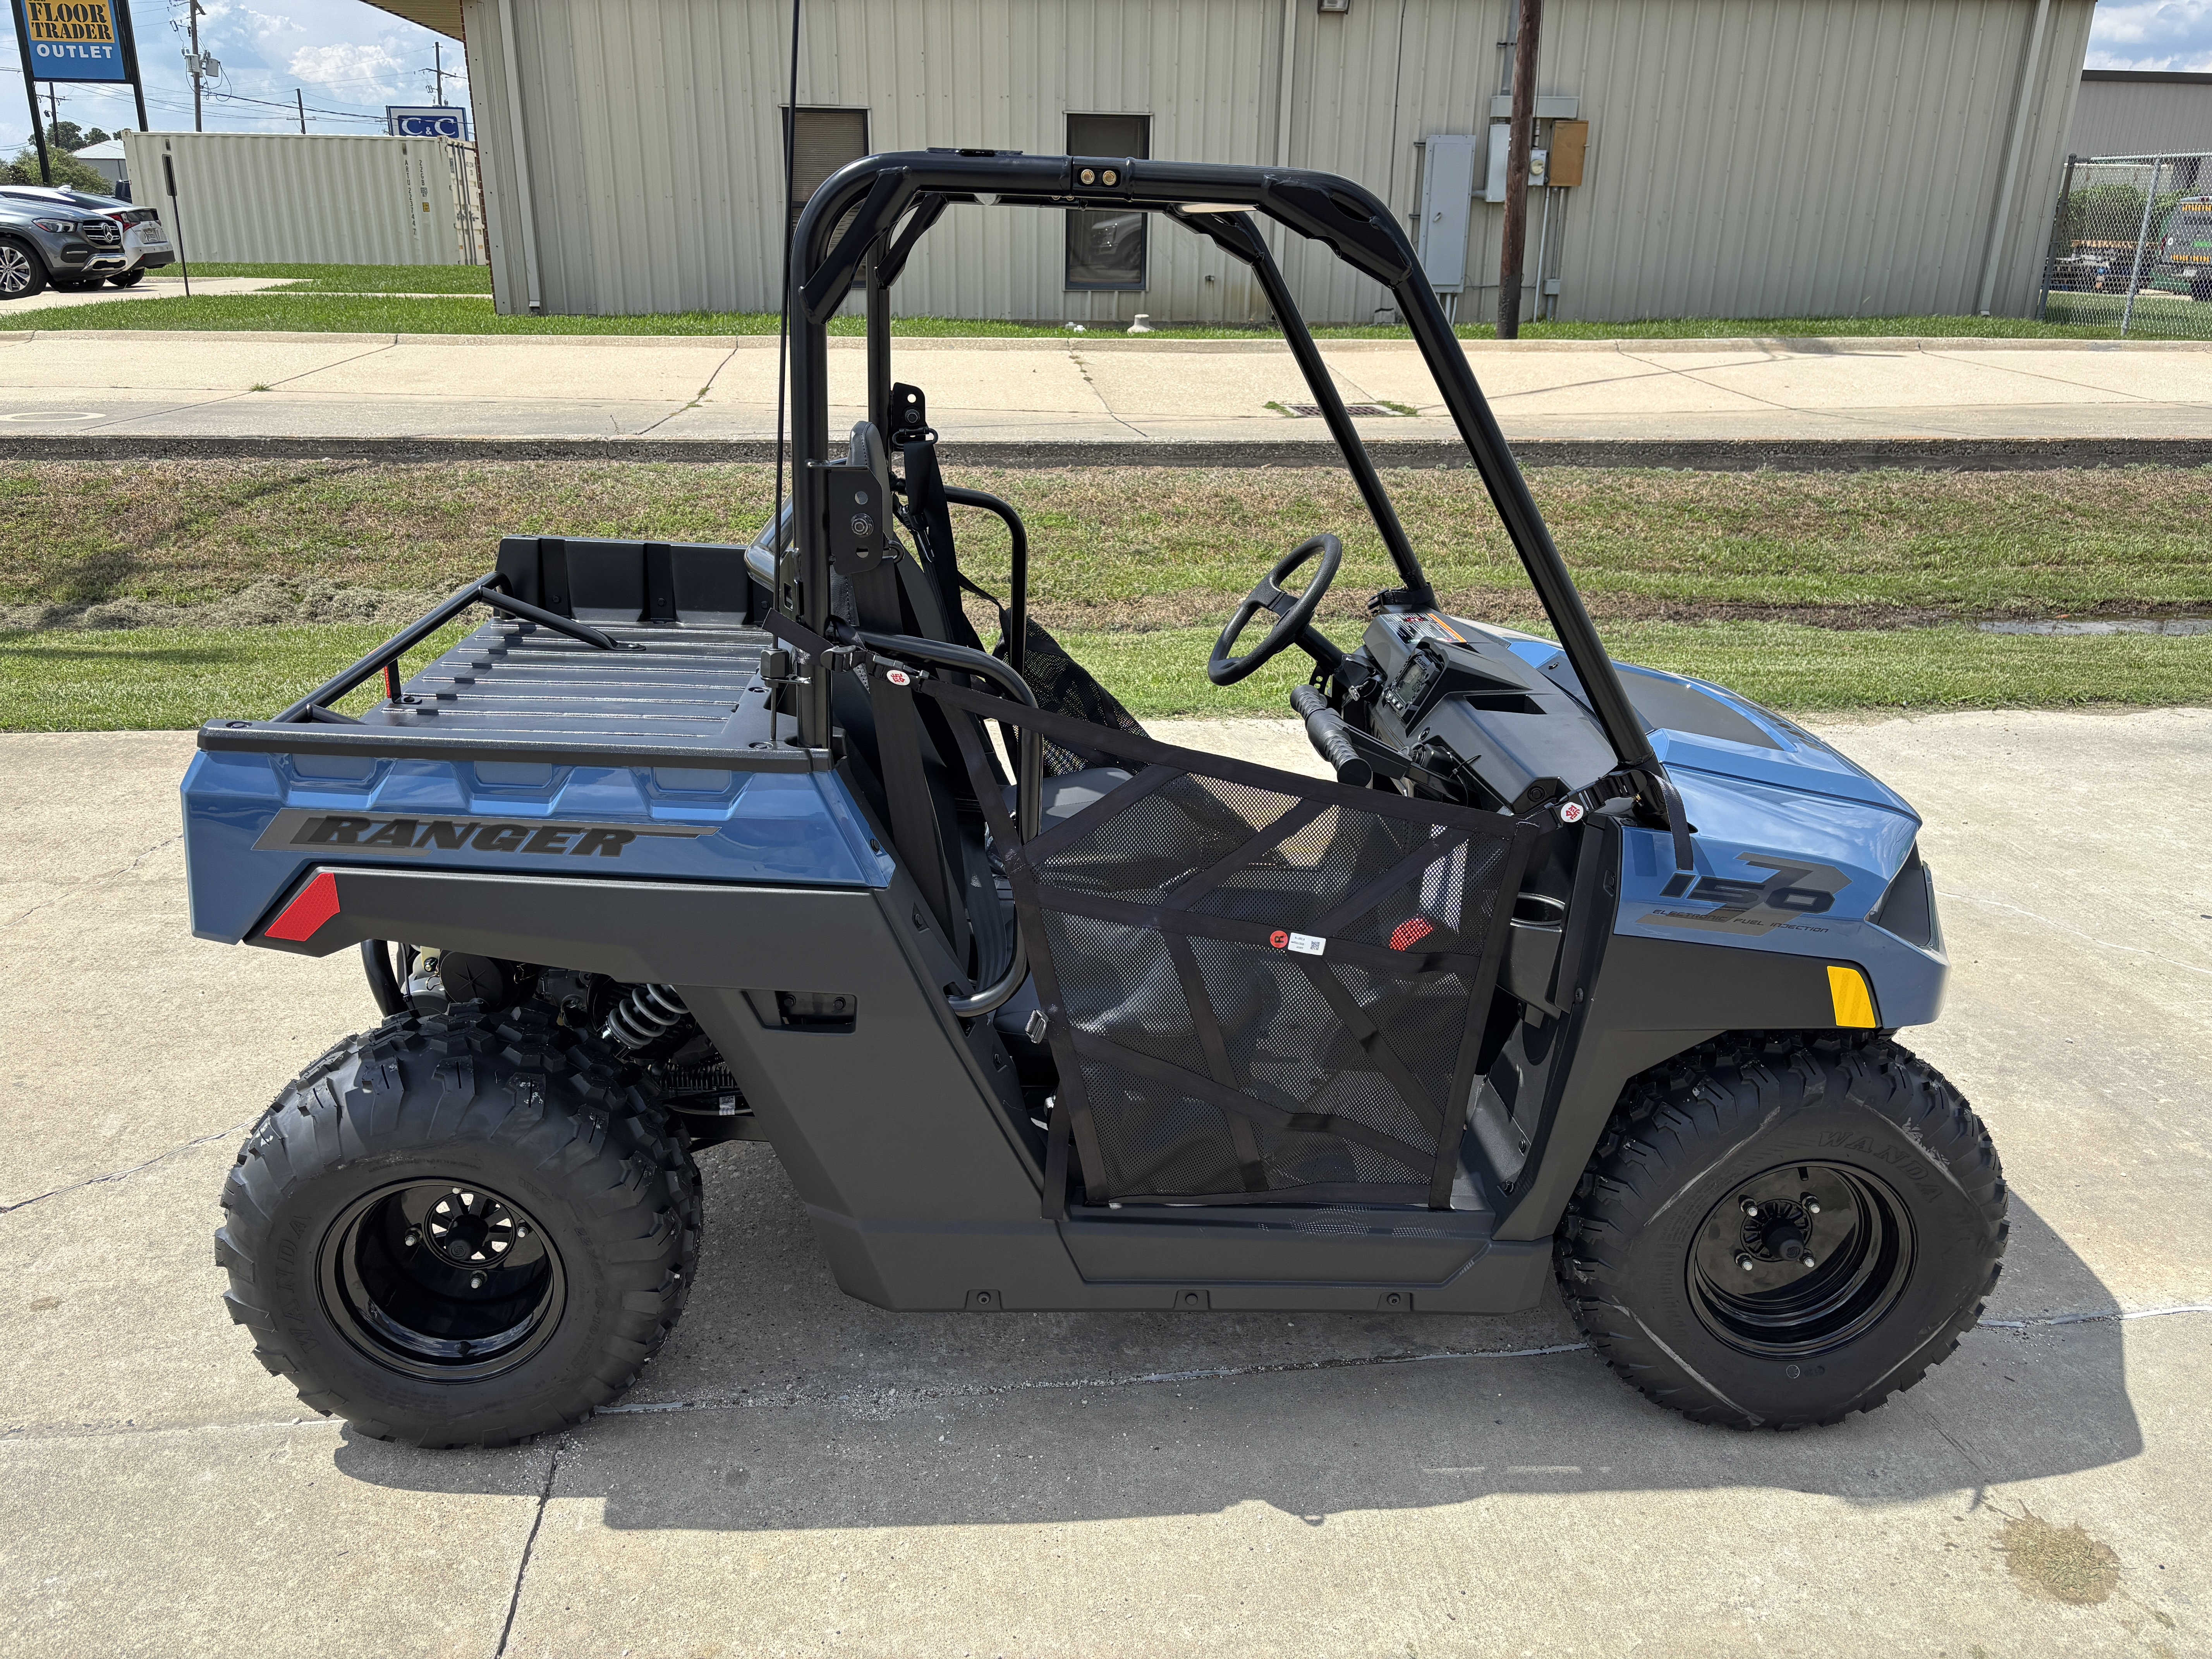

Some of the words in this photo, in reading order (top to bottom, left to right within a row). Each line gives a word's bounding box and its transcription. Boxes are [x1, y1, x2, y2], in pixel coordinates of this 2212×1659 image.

[31, 22, 112, 40] TRADER
[36, 44, 113, 58] OUTLET
[402, 117, 422, 135] C
[426, 127, 433, 135] &
[434, 118, 455, 136] C
[307, 815, 637, 857] RANGER
[1659, 873, 1836, 914] 150
[1652, 909, 1728, 922] ELECTRONIC
[1733, 918, 1764, 926] FUEL
[1769, 922, 1829, 933] INJECTION
[1274, 935, 1285, 943] R
[1819, 1131, 1944, 1203] WANDA
[275, 1215, 321, 1354] WANDA
